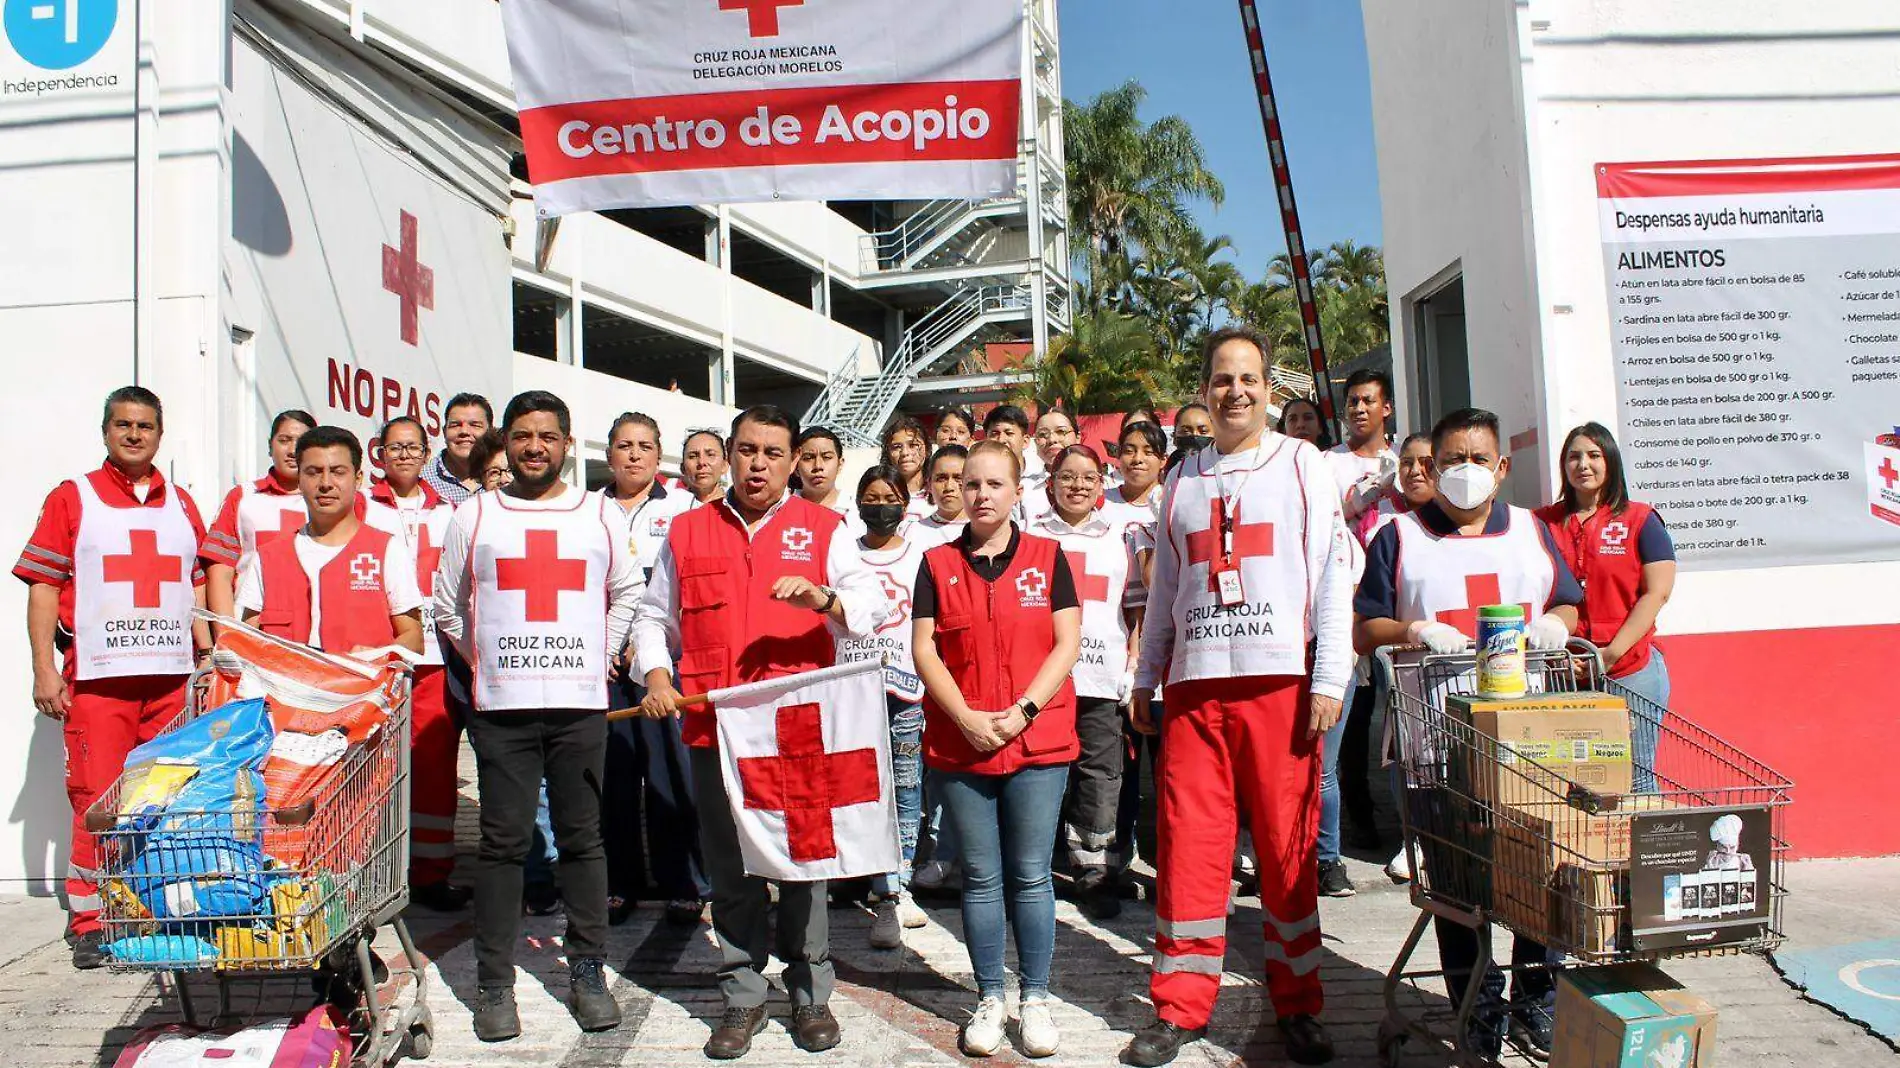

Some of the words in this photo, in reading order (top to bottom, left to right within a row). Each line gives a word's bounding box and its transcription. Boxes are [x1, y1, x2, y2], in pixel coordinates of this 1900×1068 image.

[694, 51, 729, 64] CRUZ
[732, 48, 767, 61] ROJA
[770, 44, 837, 59] MEXICANA
[693, 61, 776, 79] DELEGACIÓN
[779, 60, 843, 74] MORELOS
[4, 74, 118, 97] Independencia
[557, 115, 727, 159] Centro
[739, 105, 802, 146] de
[814, 94, 990, 150] Acopio
[1615, 211, 1691, 232] Despensas
[1694, 208, 1737, 230] ayuda
[1739, 204, 1825, 225] humanitaria
[1617, 249, 1726, 270] ALIMENTOS
[1620, 280, 1644, 288] Atún
[1662, 279, 1680, 288] lata
[1681, 278, 1704, 286] abre
[1778, 275, 1791, 283] de
[1792, 274, 1806, 282] 85
[1882, 291, 1894, 300] de
[1623, 314, 1660, 324] Sardina
[1677, 314, 1695, 322] lata
[1697, 313, 1719, 322] abre
[1743, 311, 1756, 320] de
[1758, 310, 1776, 320] 300
[1625, 335, 1660, 346] Frijoles
[1676, 334, 1702, 343] bolsa
[1704, 333, 1717, 342] de
[1719, 332, 1737, 341] 500
[1739, 334, 1750, 343] gr
[1760, 332, 1764, 340] 1
[1849, 334, 1898, 343] Chocolate
[1627, 357, 1653, 365] Arroz
[1669, 355, 1696, 364] bolsa
[1698, 354, 1710, 363] de
[1712, 353, 1730, 362] 500
[1733, 354, 1743, 363] gr
[1753, 352, 1757, 360] 1
[1629, 378, 1669, 387] Lentejas
[1686, 374, 1712, 384] bolsa
[1714, 373, 1727, 383] de
[1729, 373, 1747, 382] 500
[1749, 374, 1759, 383] gr
[1770, 372, 1774, 380] 1
[1852, 372, 1898, 383] paquetes
[327, 356, 375, 418] NO
[382, 376, 441, 437] PAS
[1631, 398, 1654, 408] Sopa
[1657, 397, 1669, 406] de
[1671, 396, 1698, 407] pasta
[1715, 394, 1740, 403] bolsa
[1742, 393, 1755, 402] de
[1758, 392, 1775, 401] 200
[1801, 391, 1820, 400] 500
[1632, 418, 1661, 427] Chiles
[1677, 417, 1696, 426] lata
[1698, 416, 1720, 425] abre
[1744, 413, 1757, 422] de
[1759, 412, 1776, 421] 380
[1682, 437, 1694, 446] de
[1696, 436, 1720, 447] pollo
[1737, 434, 1764, 445] polvo
[1766, 434, 1778, 442] de
[1781, 432, 1798, 441] 370
[1634, 460, 1664, 469] cubos
[1666, 458, 1678, 467] de
[1680, 458, 1697, 466] 140
[1636, 480, 1680, 490] Verduras
[1696, 478, 1715, 487] lata
[1717, 477, 1739, 486] abre
[1770, 475, 1794, 484] tetra
[1796, 473, 1820, 484] pack
[1822, 472, 1835, 480] de
[1669, 500, 1695, 509] bolsa
[1705, 498, 1728, 507] bote
[1730, 497, 1742, 506] de
[1745, 496, 1763, 505] 200
[1787, 494, 1791, 502] 1
[1666, 522, 1689, 530] nesa
[1691, 520, 1703, 529] de
[1705, 518, 1723, 528] 380
[1698, 540, 1734, 549] cocinar
[1736, 538, 1748, 547] de
[1751, 538, 1755, 546] 1
[1186, 604, 1221, 623] CRUZ
[1226, 602, 1274, 617] ROJA
[105, 620, 146, 632] CRUZ
[150, 619, 181, 631] ROJA
[1184, 622, 1274, 642] MEXICANA
[106, 635, 182, 648] MEXICANA
[498, 636, 540, 650] CRUZ
[544, 636, 584, 650] ROJA
[845, 640, 875, 651] CRUZ
[877, 638, 904, 652] ROJA
[1081, 636, 1106, 650] OJA
[498, 655, 584, 669] MEXICANA
